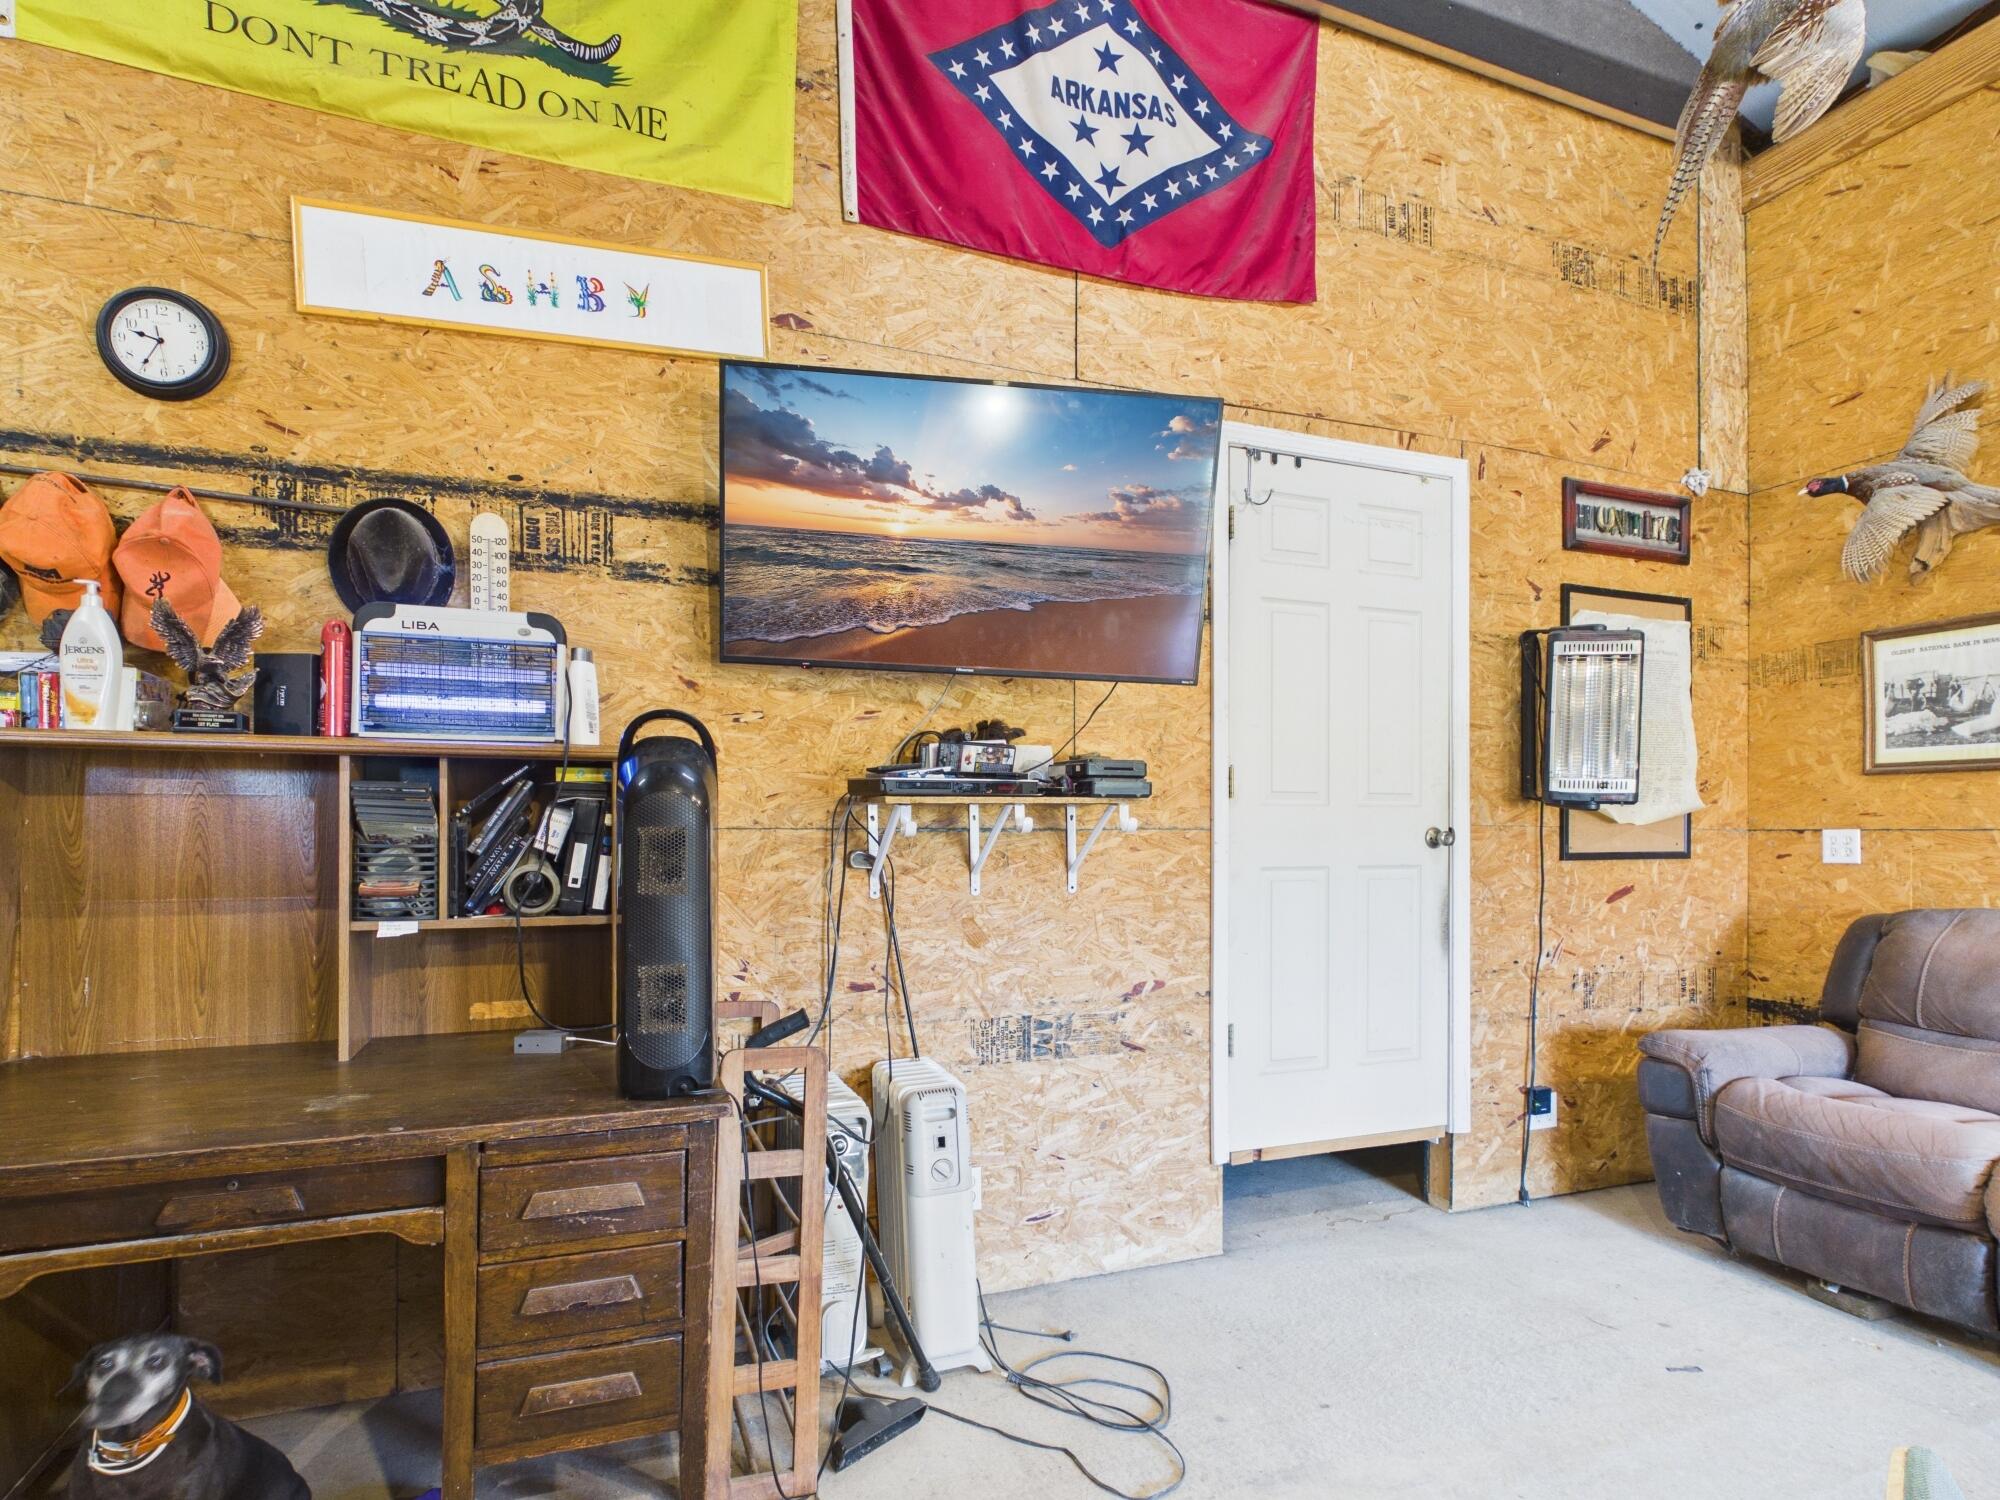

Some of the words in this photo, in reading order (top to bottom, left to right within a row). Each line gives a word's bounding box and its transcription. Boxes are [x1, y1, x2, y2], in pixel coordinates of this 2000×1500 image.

[203, 0, 354, 66] DONT
[369, 48, 527, 111] TREAD
[538, 90, 600, 123] ON
[611, 102, 668, 142] ME
[1050, 75, 1177, 128] ARKANSAS
[422, 257, 650, 319] ASHBY
[155, 304, 168, 317] 12
[525, 517, 541, 550] DOWN
[471, 536, 483, 544] 50
[495, 537, 507, 546] 120
[494, 552, 507, 560] 100
[496, 566, 507, 575] 80
[471, 574, 483, 582] 20
[496, 580, 507, 588] 60
[474, 597, 480, 605] 0
[496, 593, 508, 601] 40
[401, 620, 440, 631] LIBA
[64, 644, 105, 655] JERGENS
